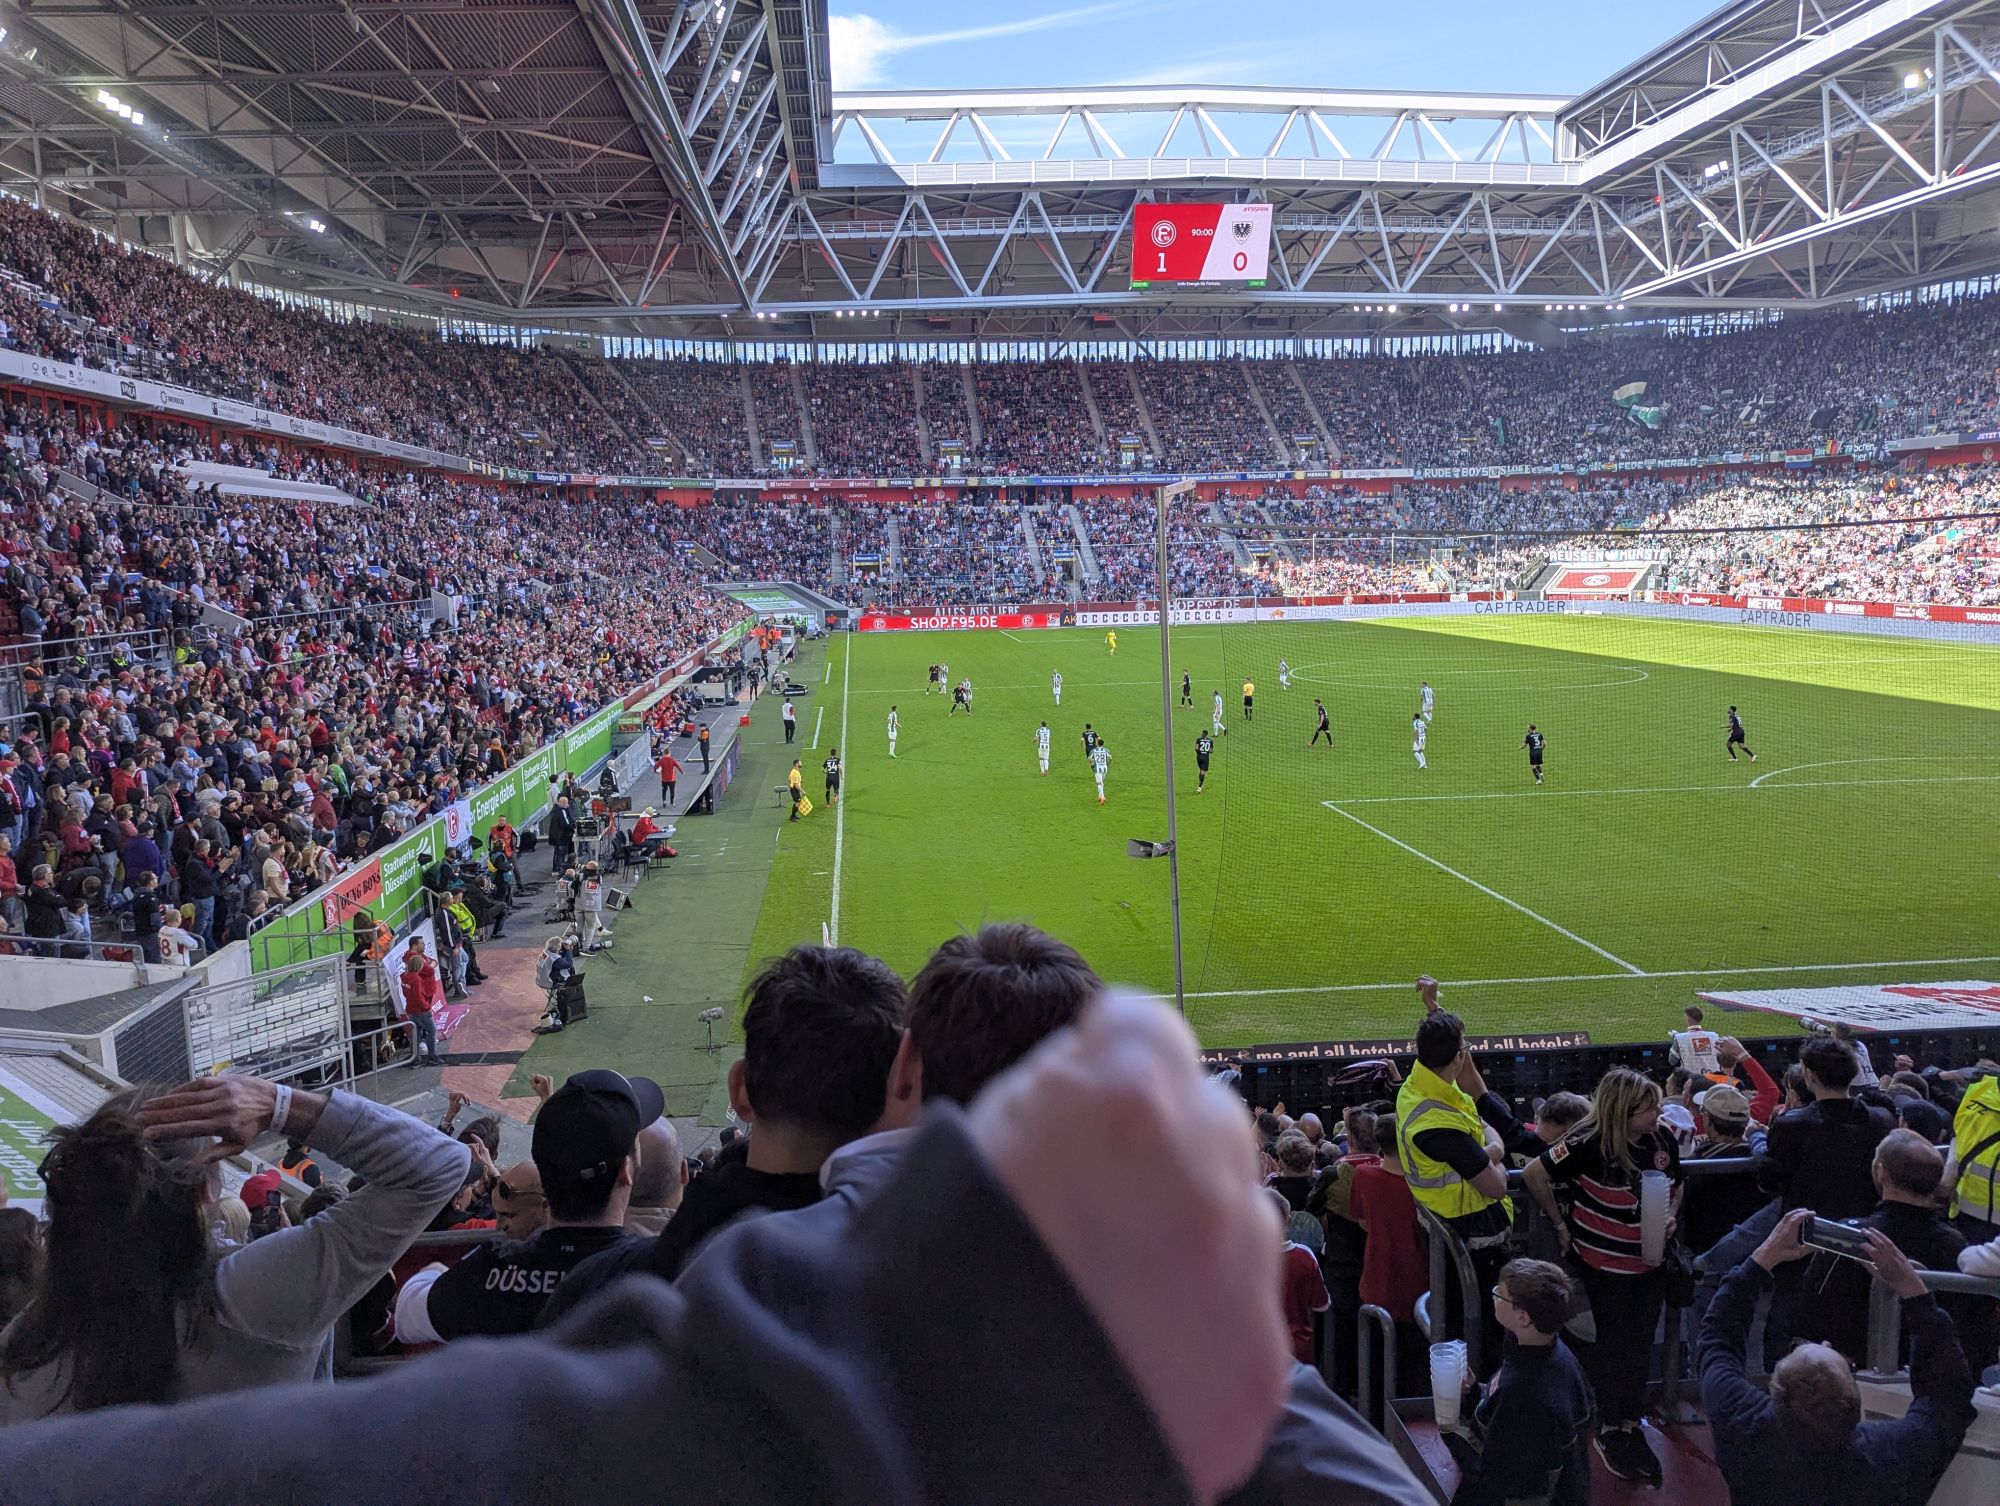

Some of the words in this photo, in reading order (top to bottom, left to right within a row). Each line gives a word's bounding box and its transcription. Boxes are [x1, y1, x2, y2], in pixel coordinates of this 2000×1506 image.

[1191, 228, 1214, 236] 90:00
[1157, 252, 1167, 273] 1
[1233, 251, 1248, 271] 0
[1425, 467, 1450, 478] RUDE
[1462, 466, 1489, 478] BOYS
[1475, 600, 1566, 614] CAPTRADER
[910, 615, 998, 630] SHOP.F95.DE
[1740, 609, 1811, 628] CAPTRADER
[1087, 734, 1094, 743] 6
[1199, 741, 1211, 752] 20
[826, 761, 838, 772] 34
[1095, 754, 1106, 763] 28
[476, 790, 500, 822] Energie
[383, 848, 416, 877] Stadtwerke
[385, 865, 417, 896] Düsseldorf
[161, 938, 172, 958] 8
[485, 1264, 566, 1294] DÜSSE
